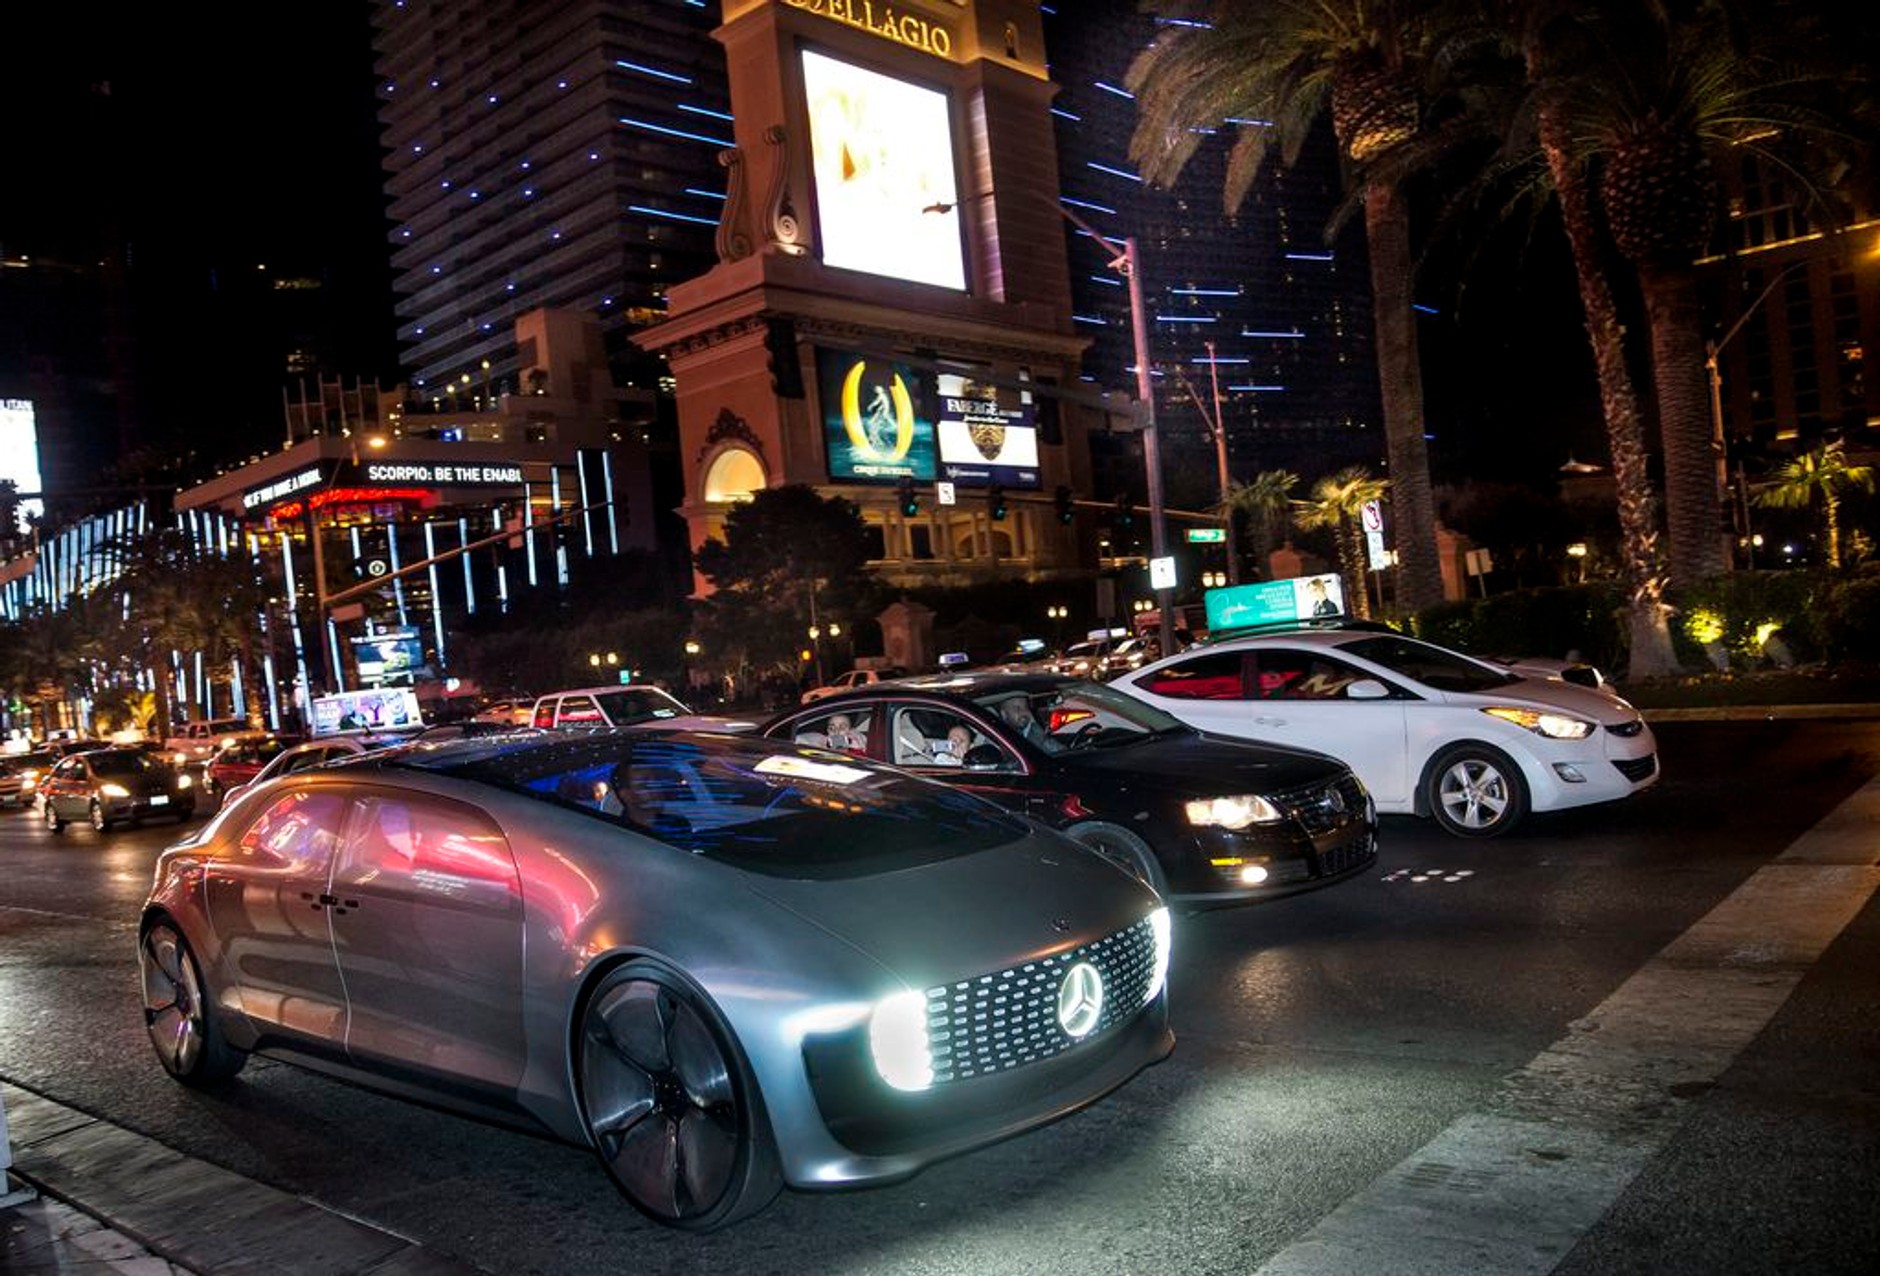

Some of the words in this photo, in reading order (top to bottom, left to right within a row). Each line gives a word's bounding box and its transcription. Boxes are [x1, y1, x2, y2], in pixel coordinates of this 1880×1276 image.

[368, 466, 432, 481] SCORPIO:
[435, 467, 453, 481] BE
[454, 468, 481, 482] THE
